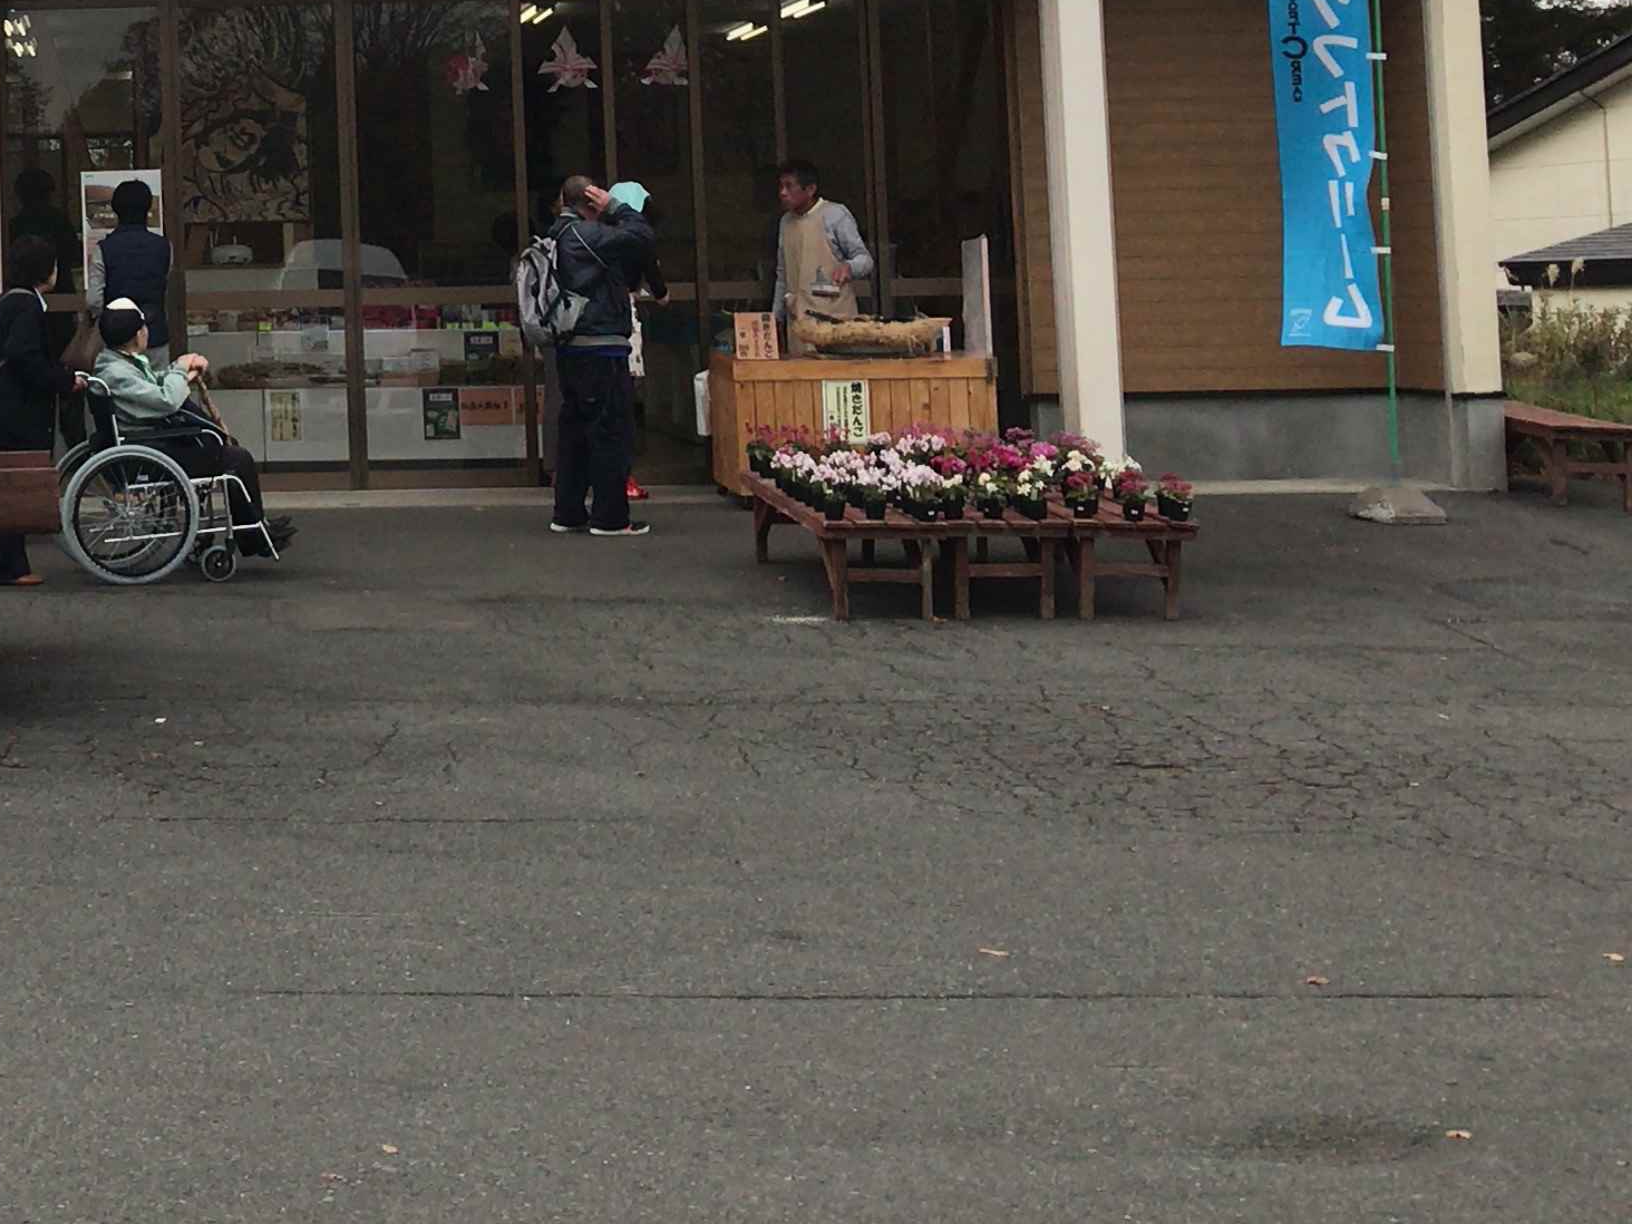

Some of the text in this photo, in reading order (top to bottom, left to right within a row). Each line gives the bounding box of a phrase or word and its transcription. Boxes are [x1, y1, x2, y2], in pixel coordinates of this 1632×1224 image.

[850, 381, 864, 438] 焼きだんご
